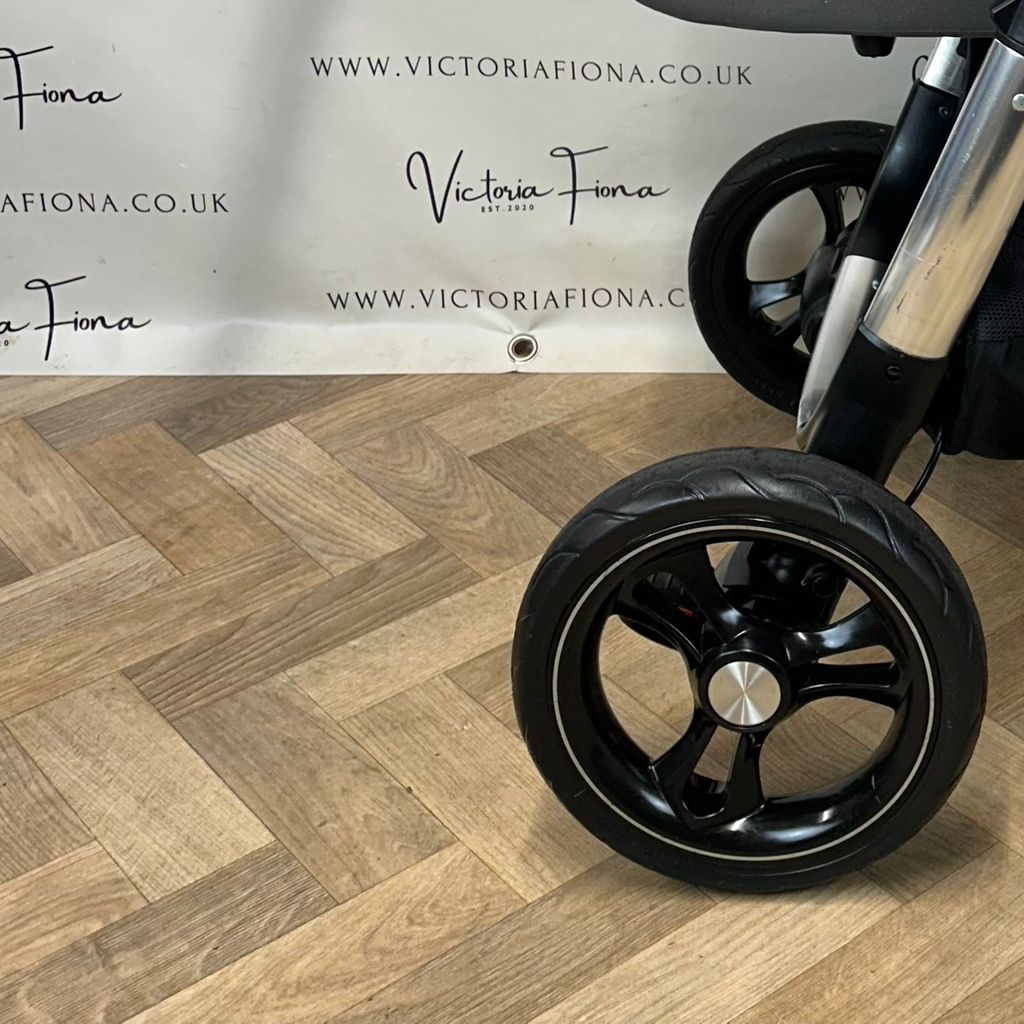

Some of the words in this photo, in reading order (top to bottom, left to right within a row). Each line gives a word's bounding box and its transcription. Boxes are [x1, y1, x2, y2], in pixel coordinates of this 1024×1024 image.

[0, 46, 122, 130] Fiona
[310, 56, 753, 85] WWW.VICTORIAFIONA.CO.UK
[406, 150, 554, 224] Victoria
[550, 146, 670, 225] Fiona
[481, 205, 535, 213] EST.2020
[25, 276, 152, 361] Fiona
